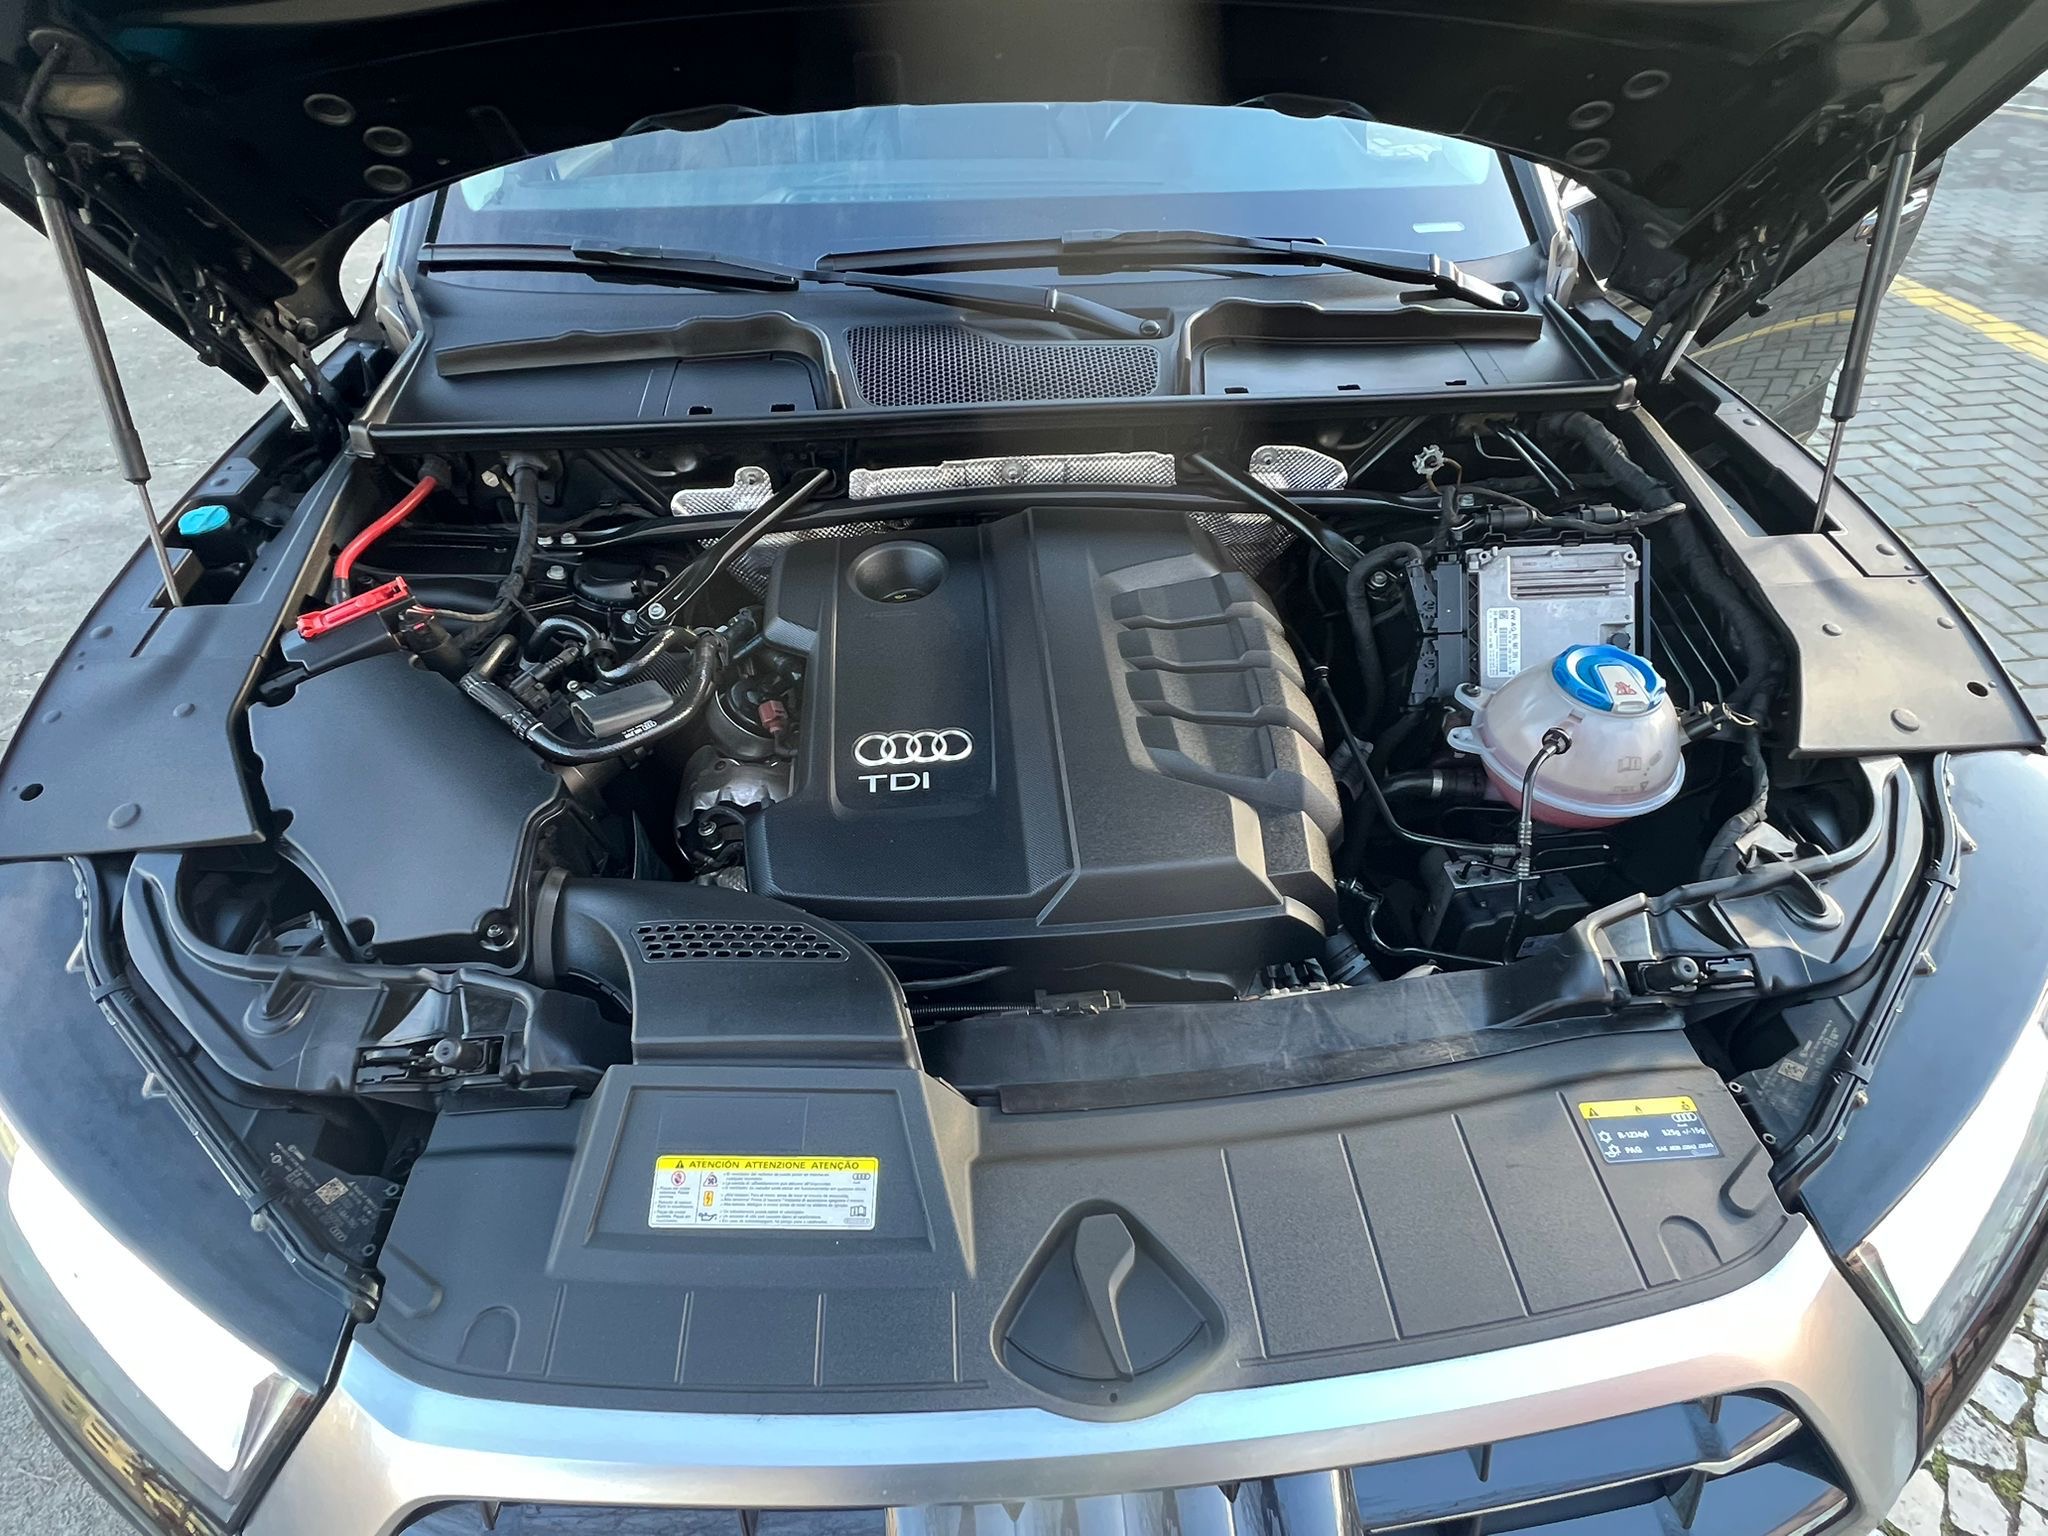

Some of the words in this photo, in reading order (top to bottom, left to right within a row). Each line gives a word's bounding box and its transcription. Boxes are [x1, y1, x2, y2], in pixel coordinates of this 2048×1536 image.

[858, 771, 930, 793] TDI
[689, 1159, 740, 1170] ATENCIÓN
[745, 1160, 806, 1170] ATTENZIONE
[811, 1159, 860, 1172] ATENÇÃO
